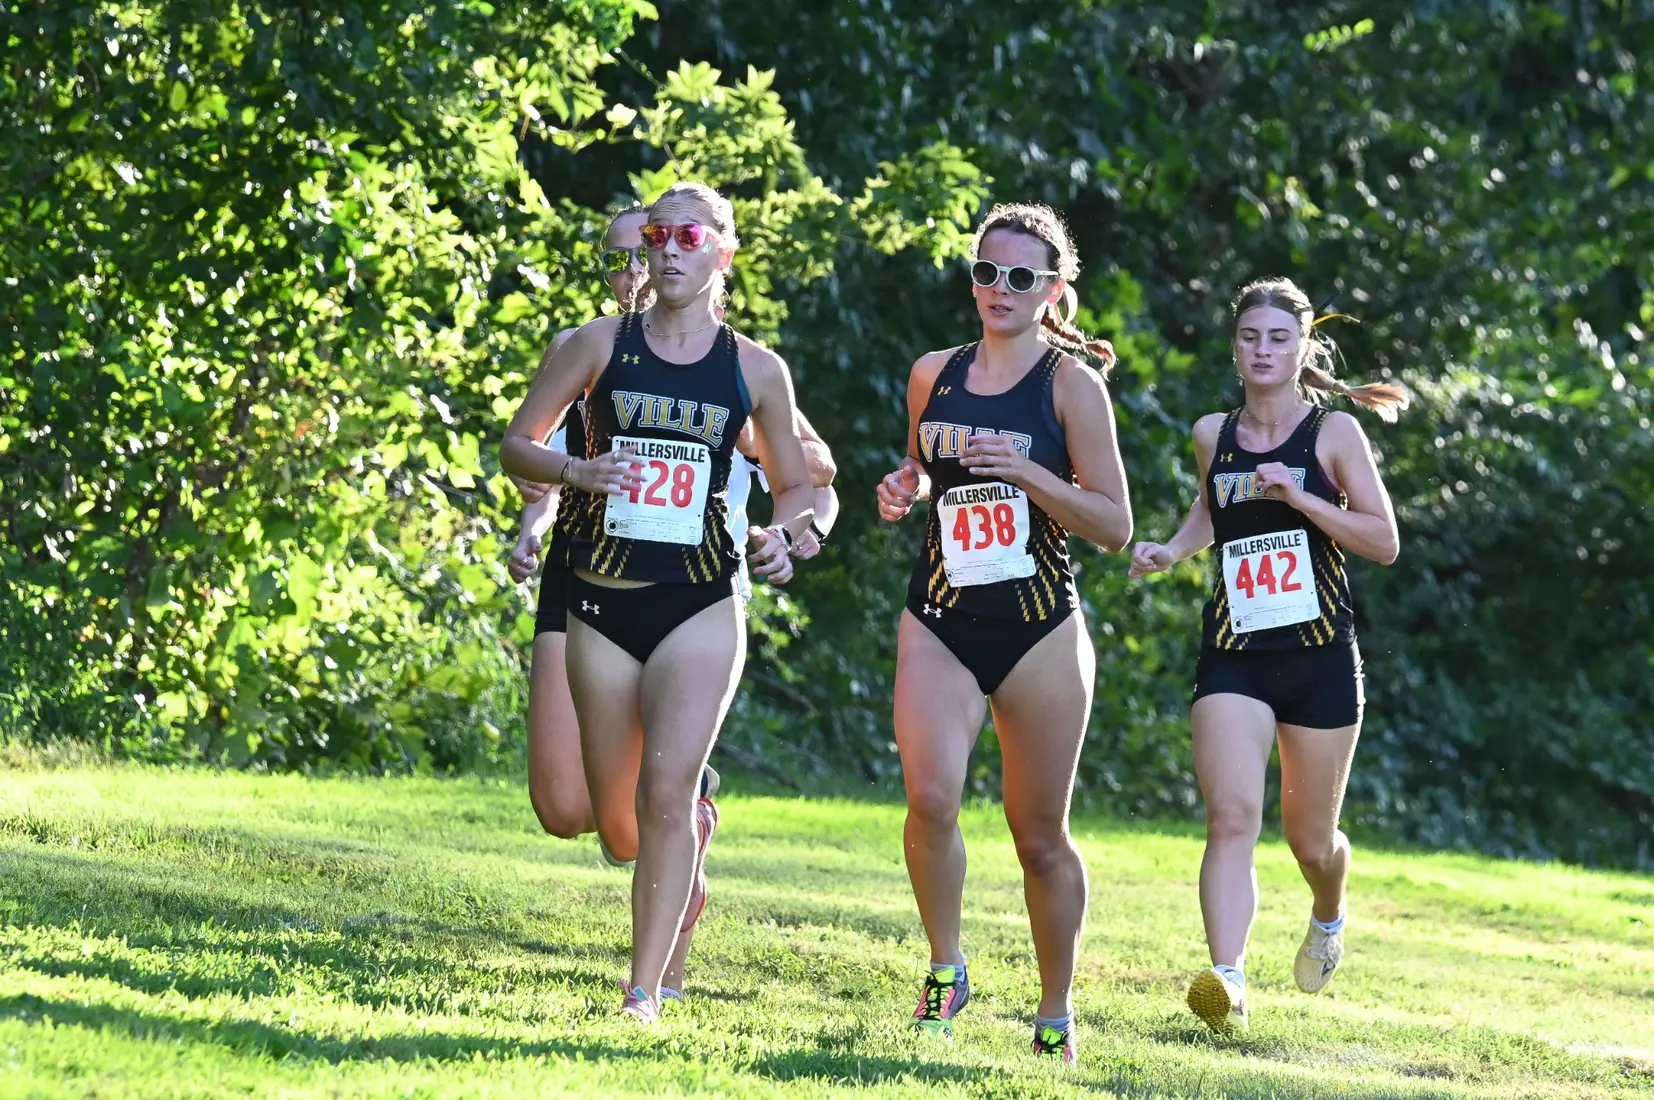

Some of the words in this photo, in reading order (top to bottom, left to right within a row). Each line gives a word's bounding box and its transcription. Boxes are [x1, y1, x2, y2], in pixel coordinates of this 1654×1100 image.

[612, 390, 729, 448] VILLE
[919, 421, 1032, 462] VIL
[619, 459, 696, 509] 428
[943, 485, 1020, 507] MILLERSVILLE
[1213, 467, 1306, 508] VIL
[952, 503, 1016, 552] 438
[1229, 533, 1302, 559] MILLERSVILLE
[1235, 550, 1302, 599] 442
